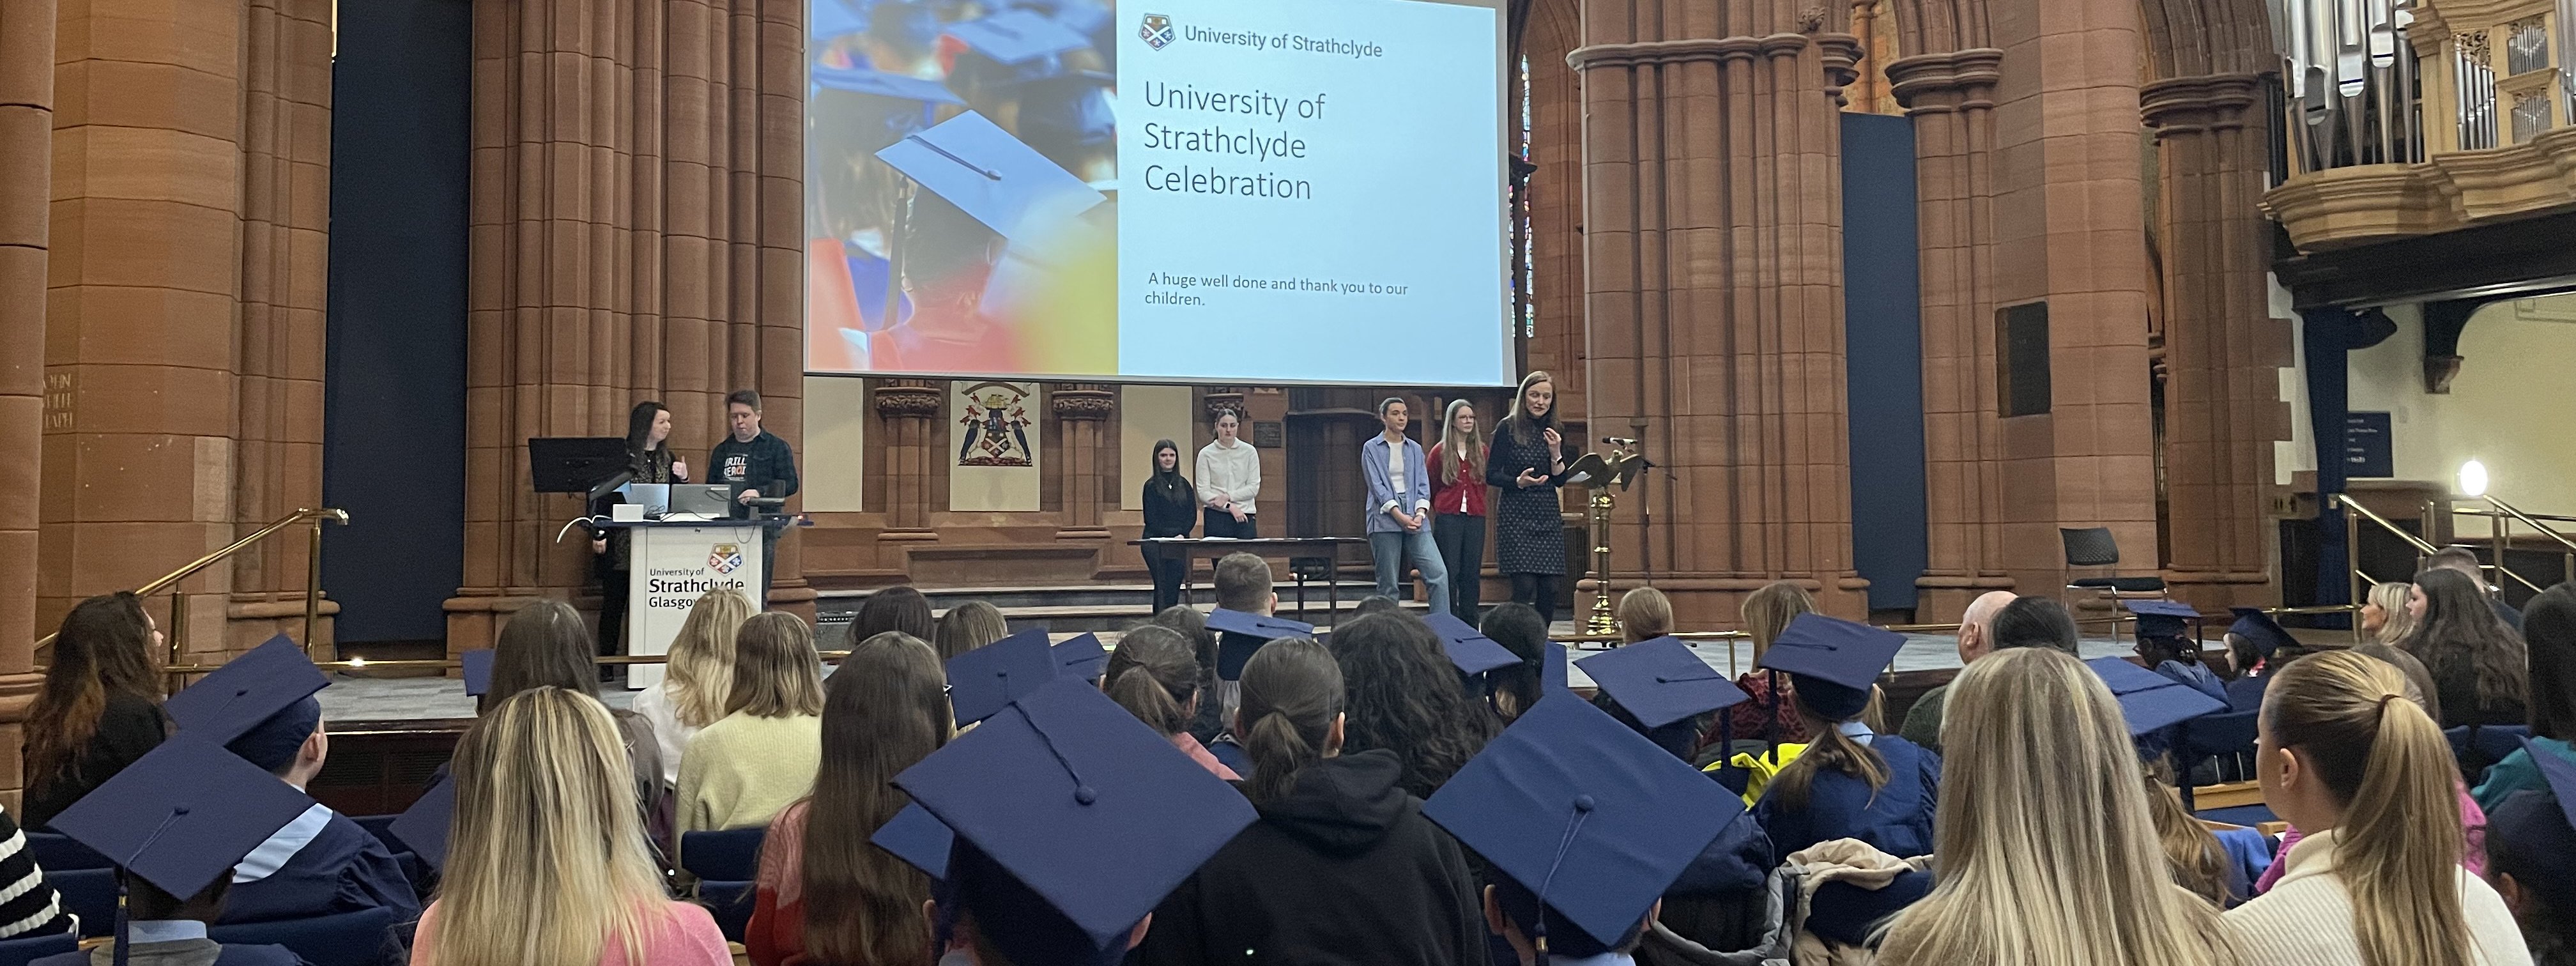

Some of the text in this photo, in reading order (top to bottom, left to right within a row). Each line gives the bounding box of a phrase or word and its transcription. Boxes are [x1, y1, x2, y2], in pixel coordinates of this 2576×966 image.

[1185, 24, 1383, 59] University of Strathclyde
[1146, 80, 1327, 123] University of
[1144, 123, 1306, 163] Strathclyde
[1145, 164, 1310, 200] Celebration
[1145, 290, 1206, 306] children.
[1148, 272, 1408, 296] A huge well done and thank you to our
[650, 567, 695, 577] University
[649, 597, 696, 610] Glasgo
